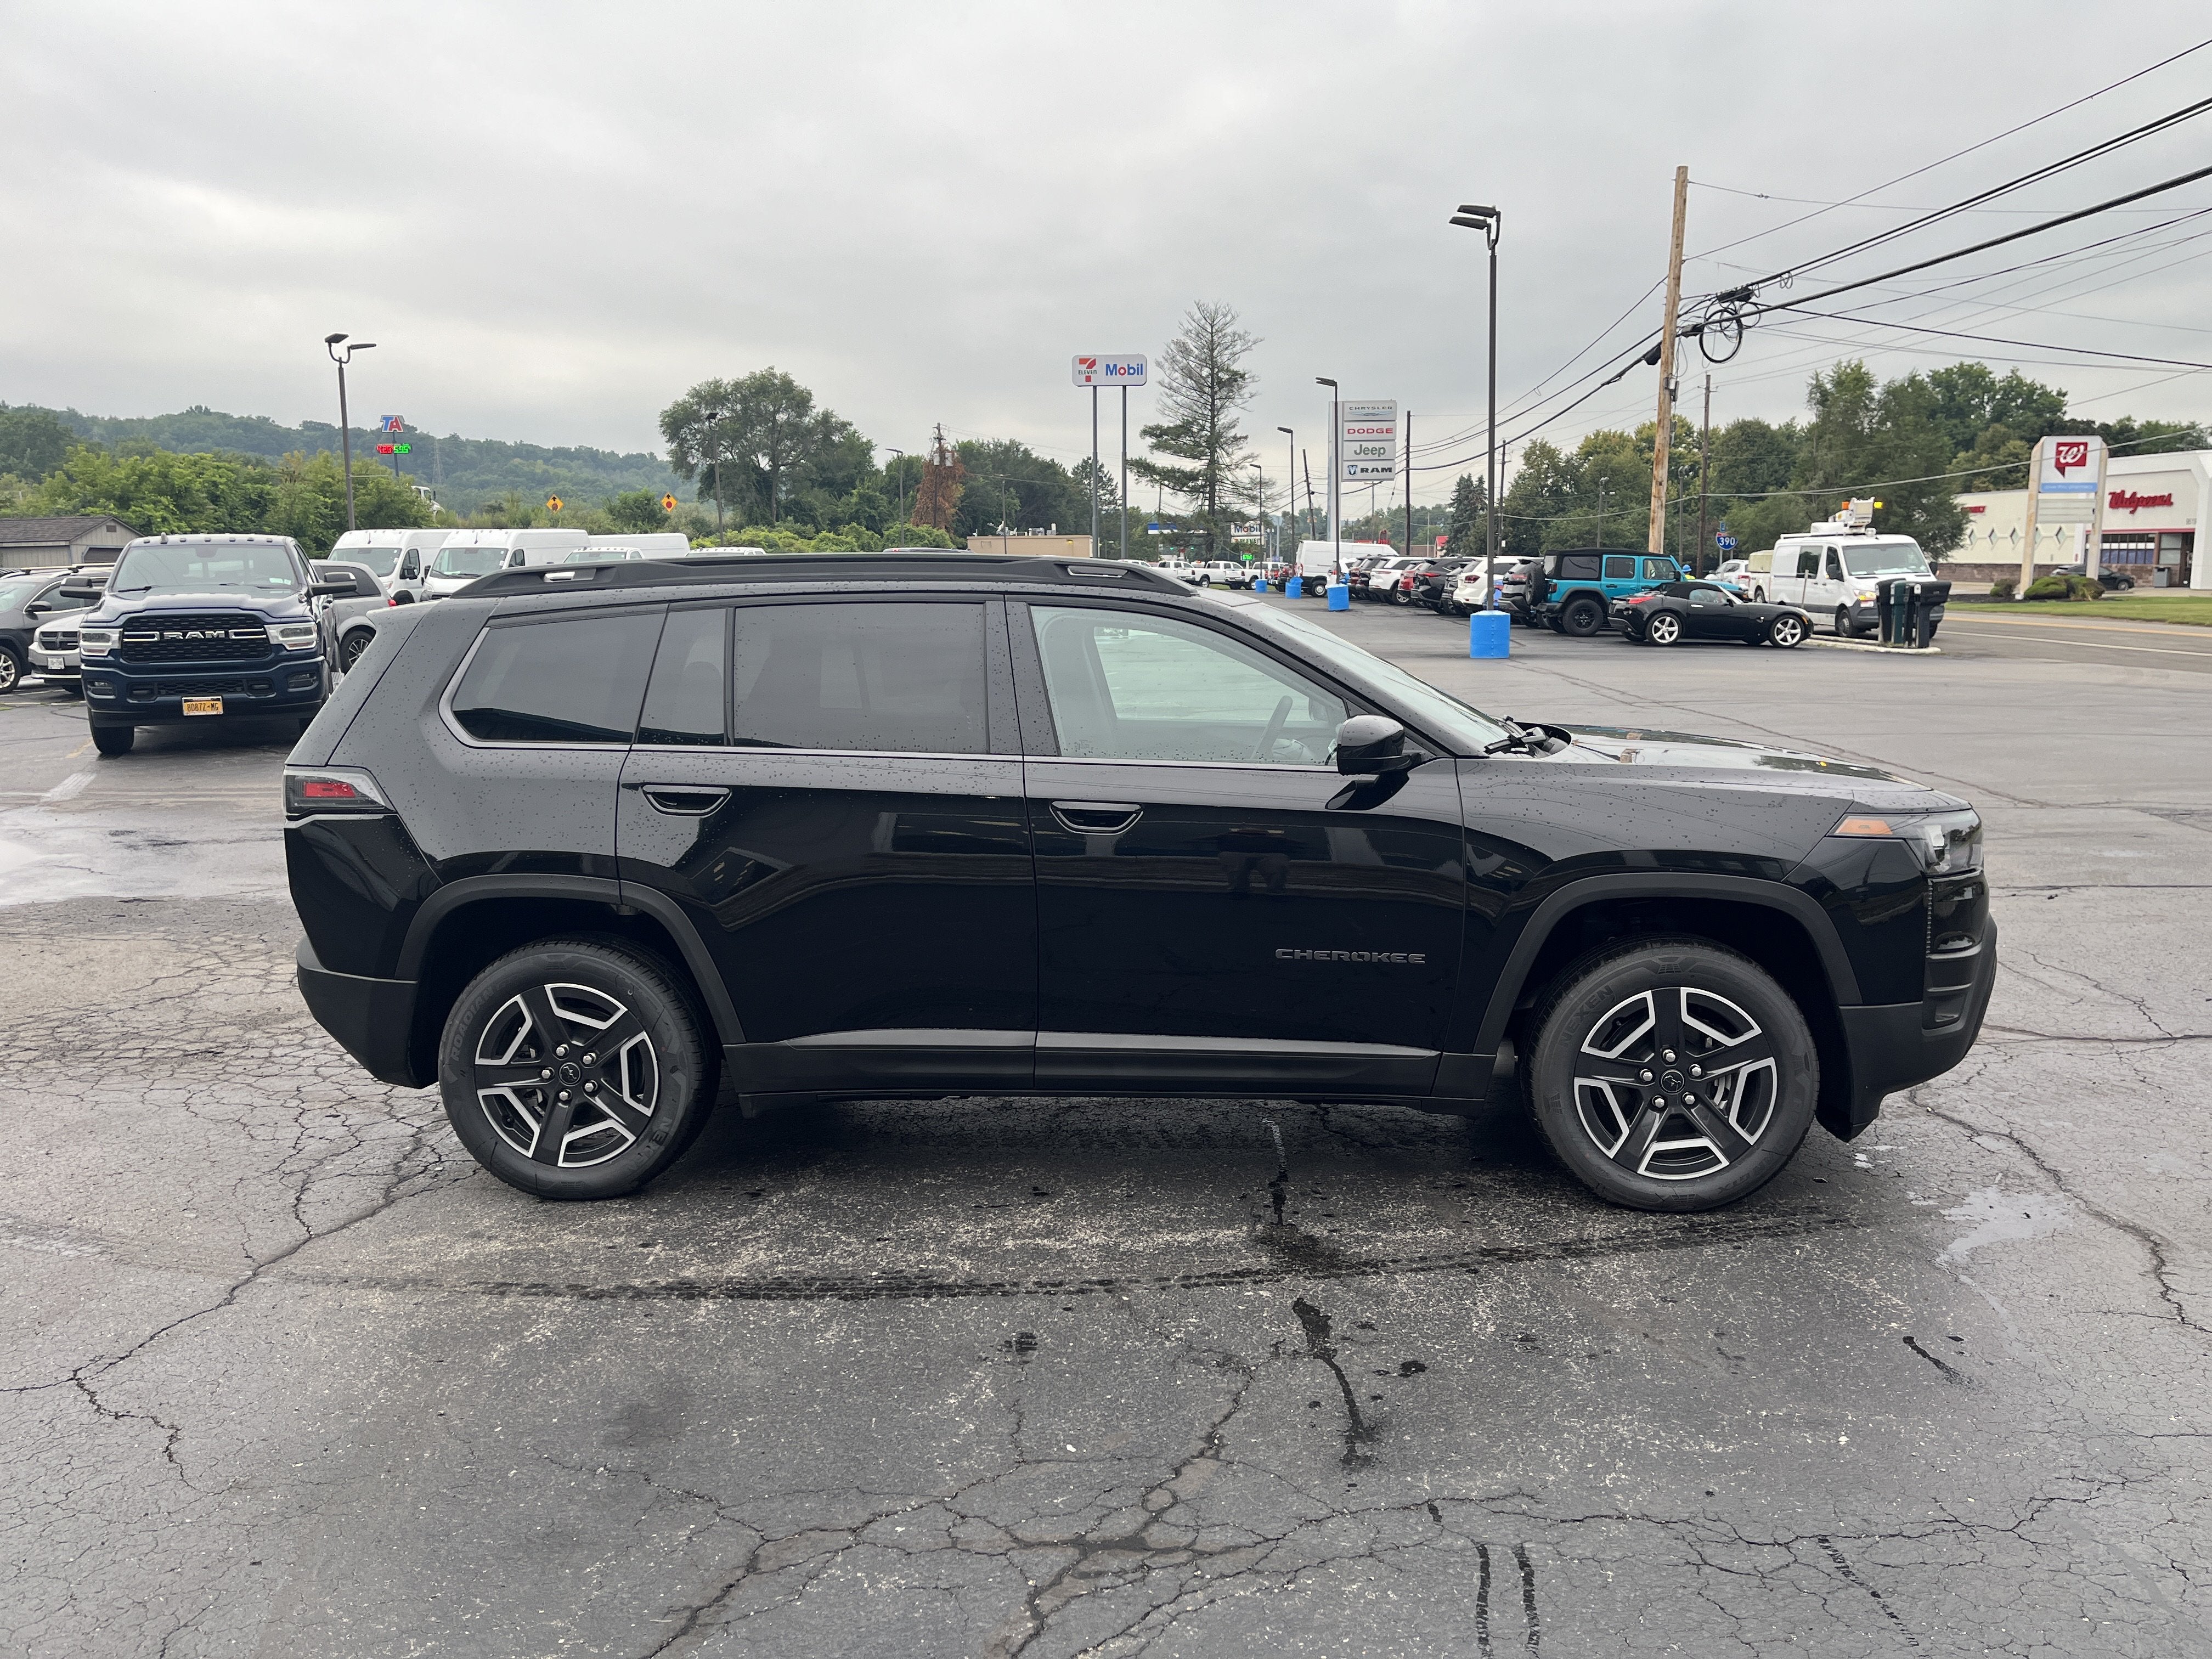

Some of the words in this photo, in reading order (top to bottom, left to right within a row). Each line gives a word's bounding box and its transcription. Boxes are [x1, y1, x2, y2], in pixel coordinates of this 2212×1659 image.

[1105, 363, 1143, 376] Mobil
[381, 415, 404, 432] TA
[1353, 444, 1386, 458] Jeep
[2108, 490, 2174, 515] Walgreens
[1719, 537, 1736, 545] 390
[163, 630, 225, 640] RAM
[1275, 949, 1426, 964] CHEROKEE
[1557, 984, 1615, 1049] NEXEN
[450, 987, 495, 1063] ROADIAN
